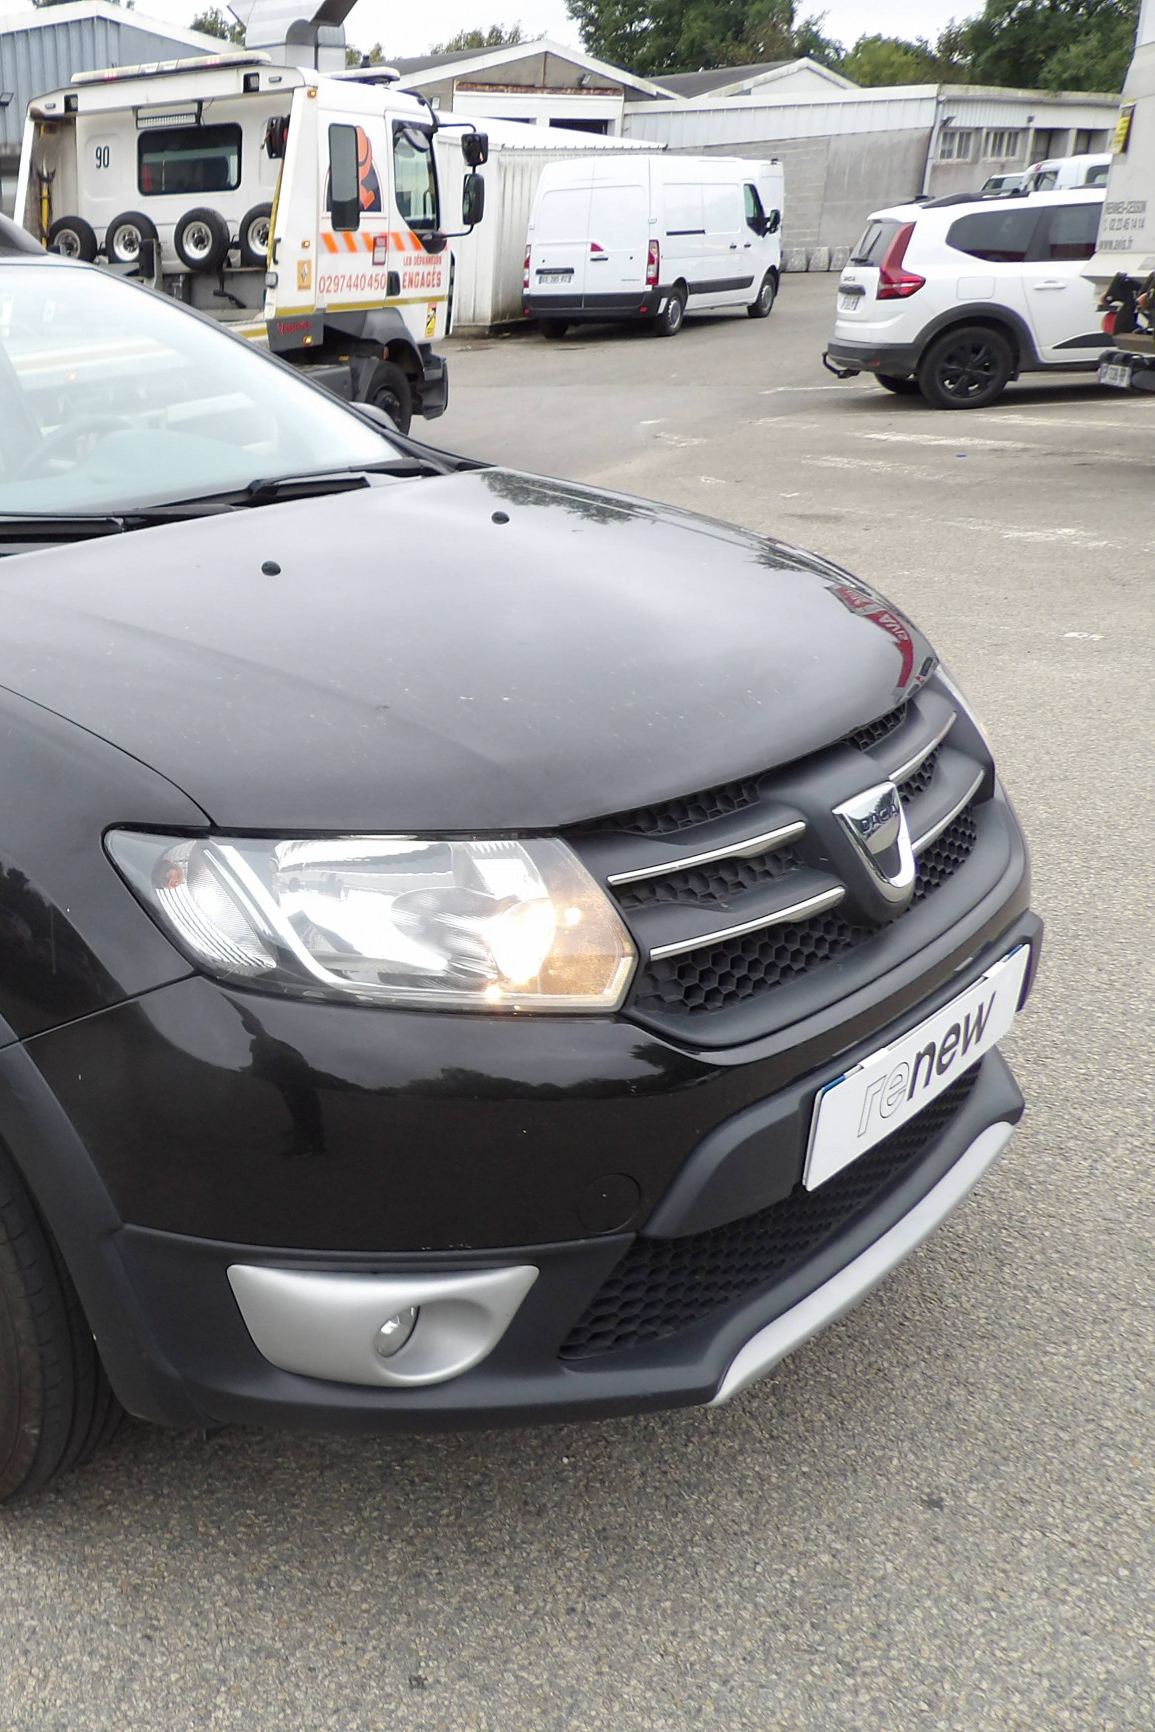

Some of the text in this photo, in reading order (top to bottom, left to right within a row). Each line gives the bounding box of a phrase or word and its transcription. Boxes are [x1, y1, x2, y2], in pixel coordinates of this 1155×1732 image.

[96, 146, 109, 168] 90
[318, 273, 386, 294] 0297440450
[402, 267, 442, 289] ENGAGÉS
[860, 803, 898, 834] DACIA
[857, 990, 996, 1138] renew
